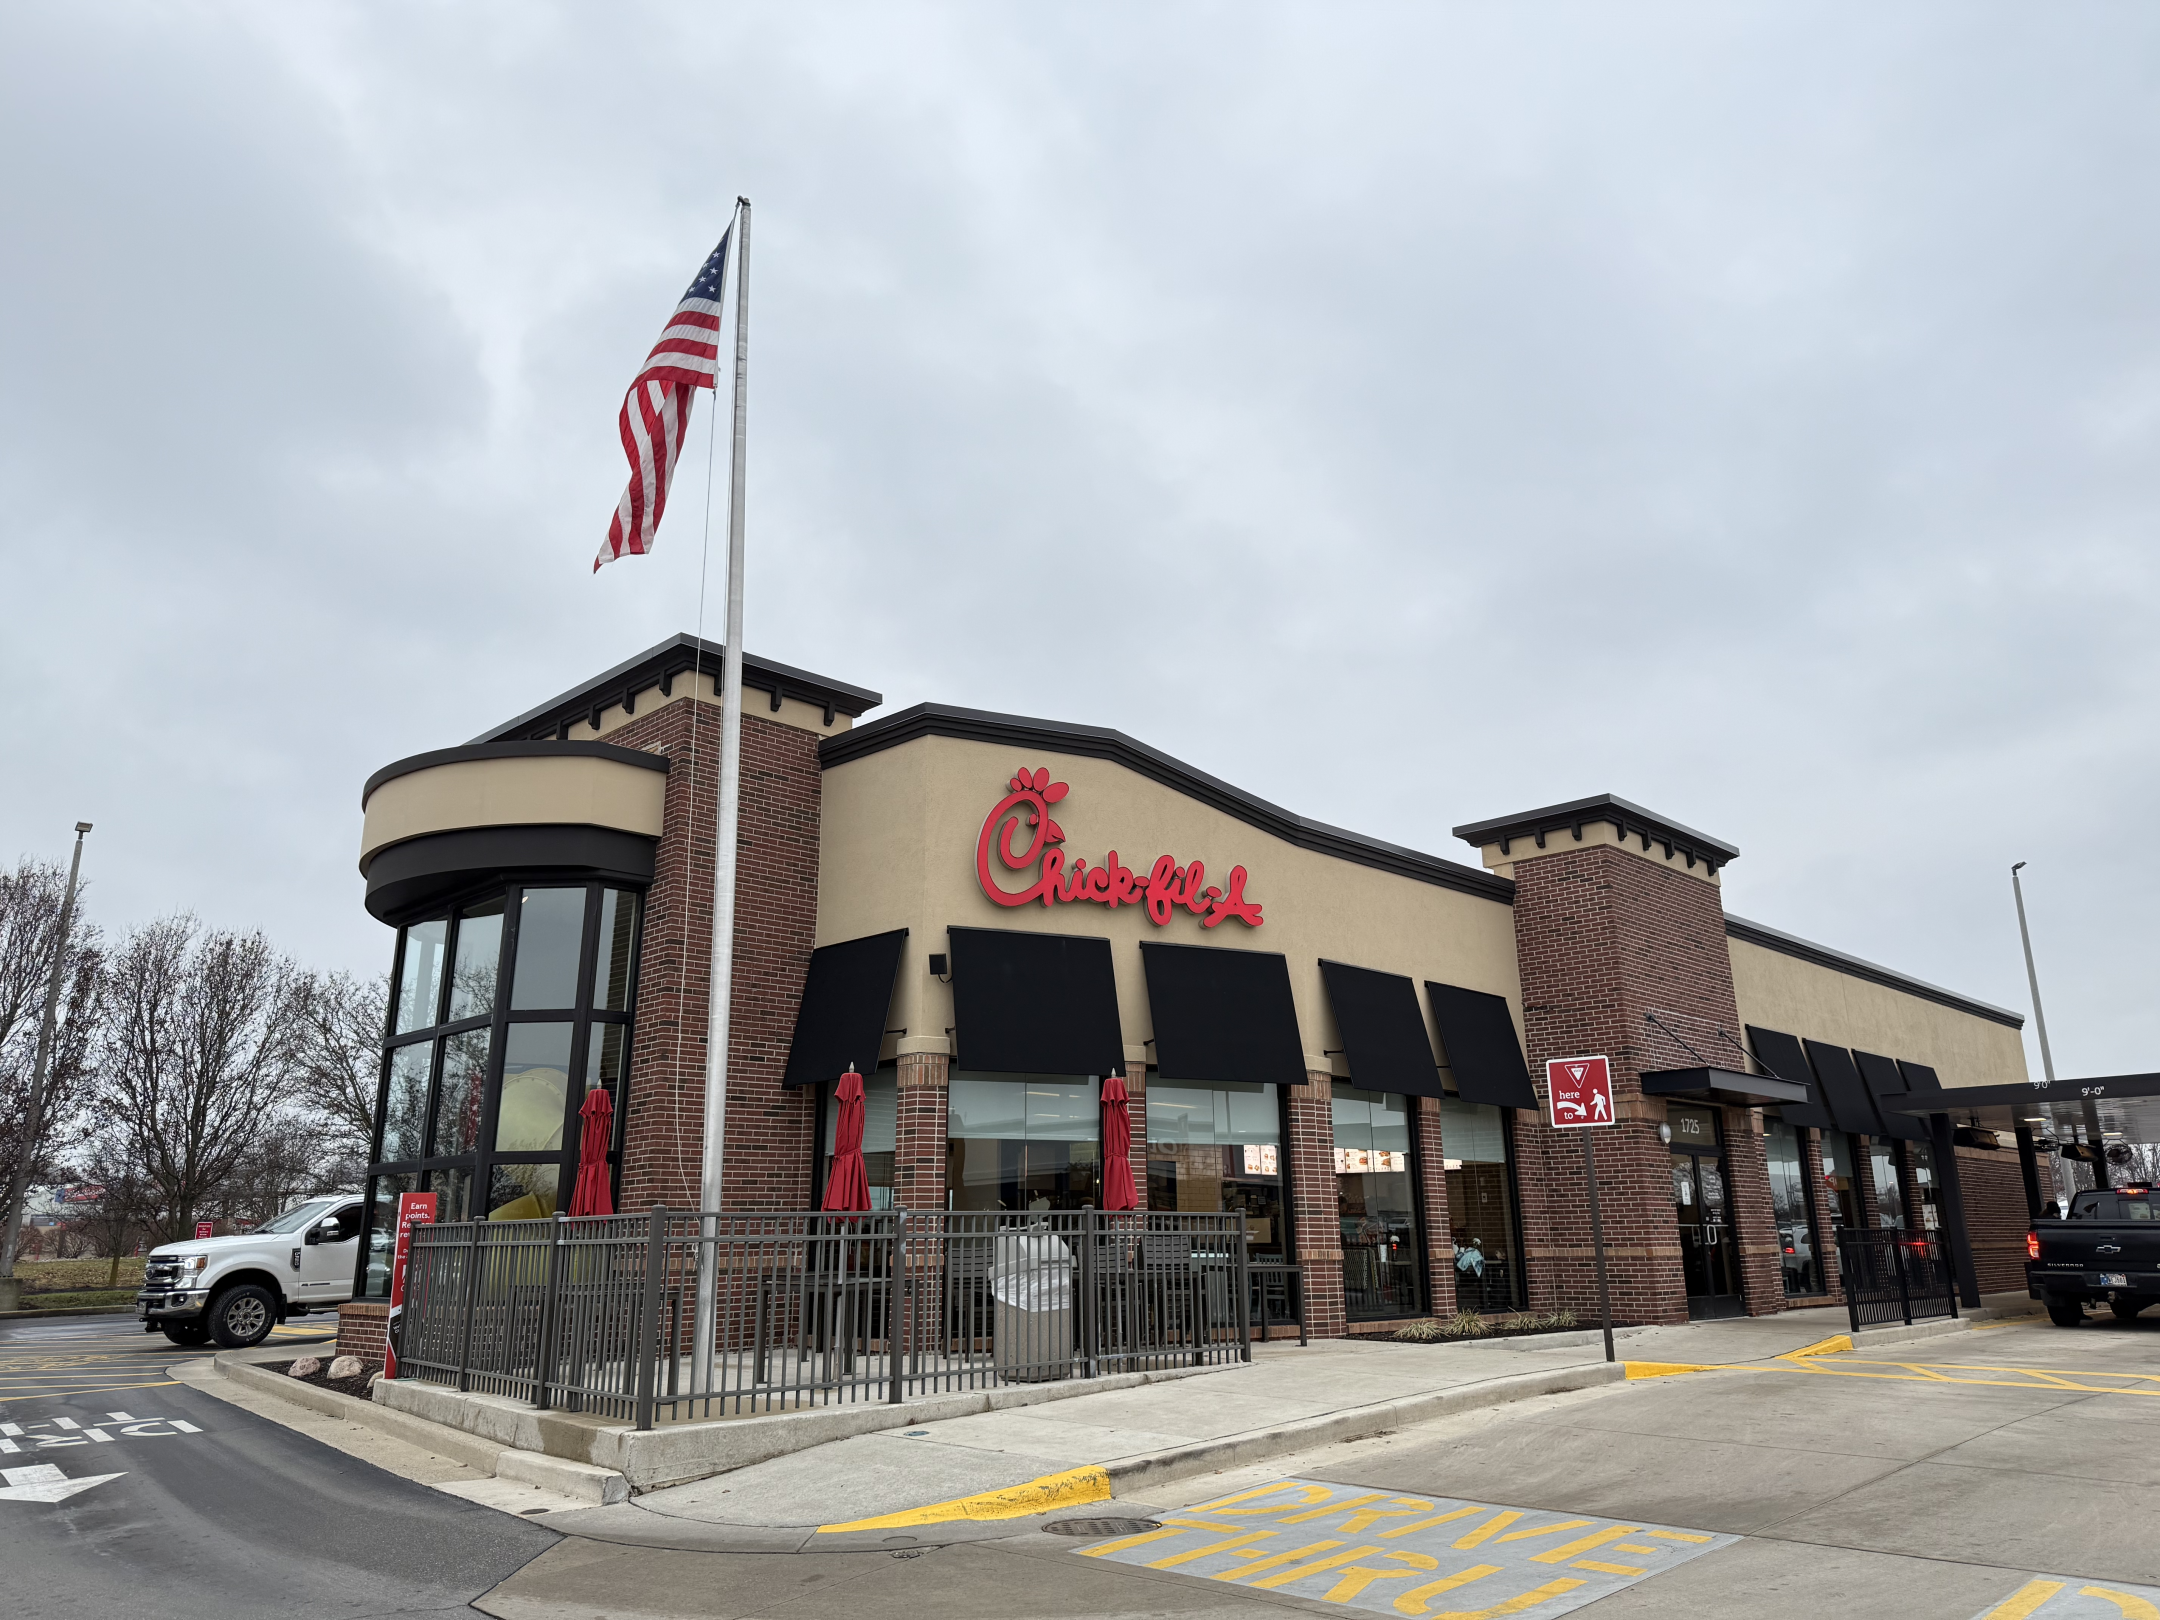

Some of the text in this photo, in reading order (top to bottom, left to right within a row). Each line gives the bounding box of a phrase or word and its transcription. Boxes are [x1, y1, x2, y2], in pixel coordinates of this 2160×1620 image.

[975, 767, 1264, 928] Chick-fil-A
[1558, 1090, 1580, 1100] here
[1563, 1111, 1574, 1120] to
[1680, 1117, 1700, 1134] 1725
[410, 1202, 428, 1210] Earn
[405, 1211, 431, 1221] points.
[1184, 1481, 1713, 1578] DRIVE
[1078, 1518, 1589, 1620] THRU
